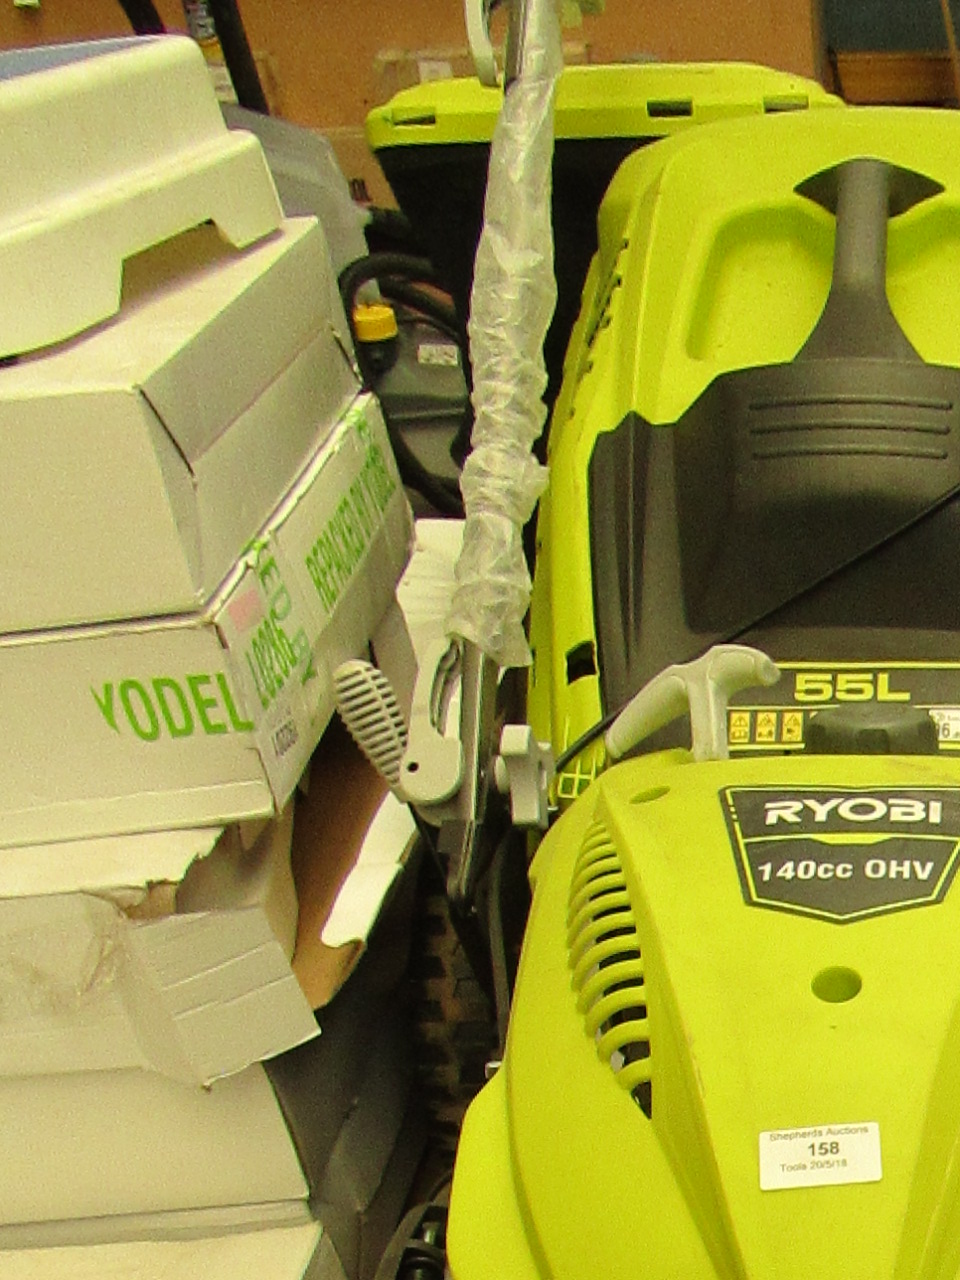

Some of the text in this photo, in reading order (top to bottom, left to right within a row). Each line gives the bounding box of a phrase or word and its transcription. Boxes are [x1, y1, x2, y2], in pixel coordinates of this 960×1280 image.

[794, 672, 911, 702] 55L
[90, 671, 255, 742] YODEL
[764, 797, 943, 826] RYOBI
[758, 858, 935, 883] 140cc OHV
[769, 1125, 869, 1142] Shepherds Auctions
[807, 1141, 840, 1157] 158
[780, 1158, 848, 1173] Tools 20/5/18
